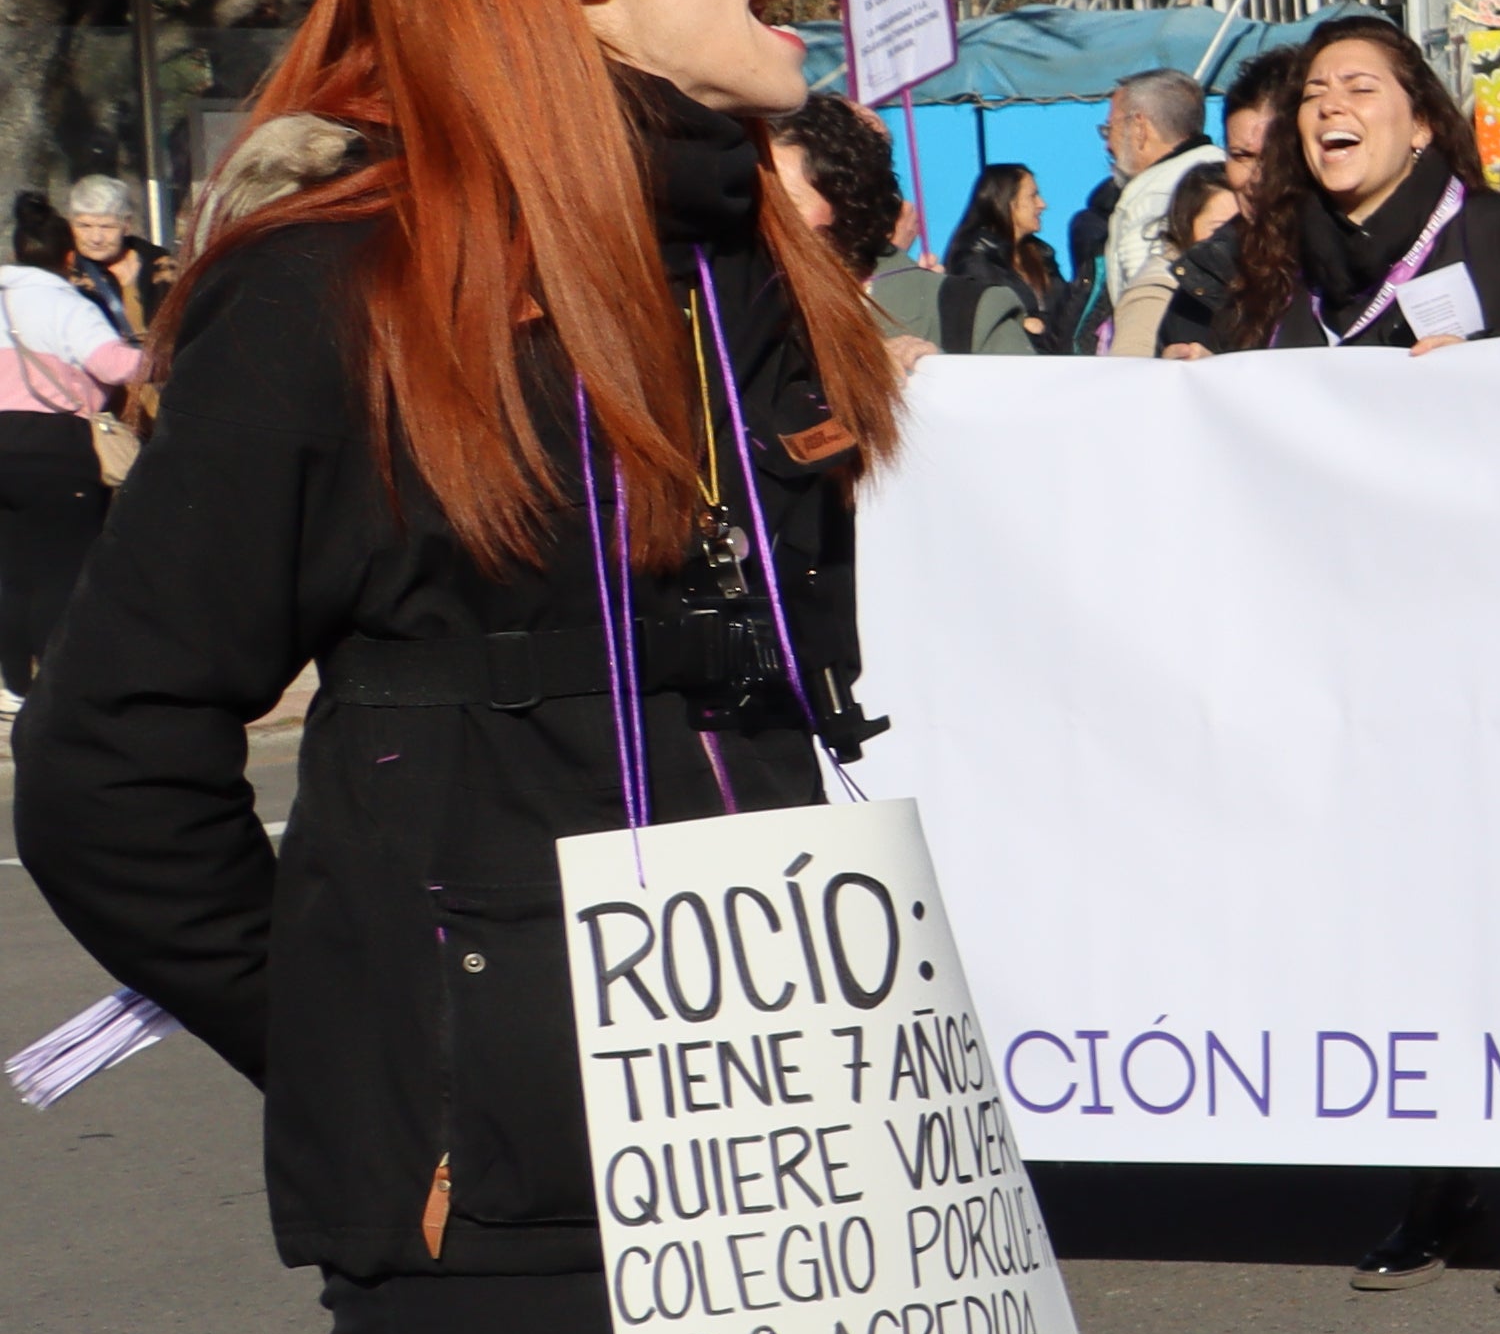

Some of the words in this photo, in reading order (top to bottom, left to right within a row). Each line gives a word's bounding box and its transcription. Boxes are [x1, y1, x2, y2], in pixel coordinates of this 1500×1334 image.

[575, 851, 936, 1028] ROCÍO:
[591, 1028, 815, 1123] TIENE
[829, 1026, 872, 1104] 7
[1001, 1013, 1272, 1120] CIÓN
[1313, 1027, 1439, 1120] DE
[602, 1123, 868, 1227] QUIERE
[611, 1213, 879, 1326] COLEGIO
[904, 1184, 1042, 1287] PORQUE
